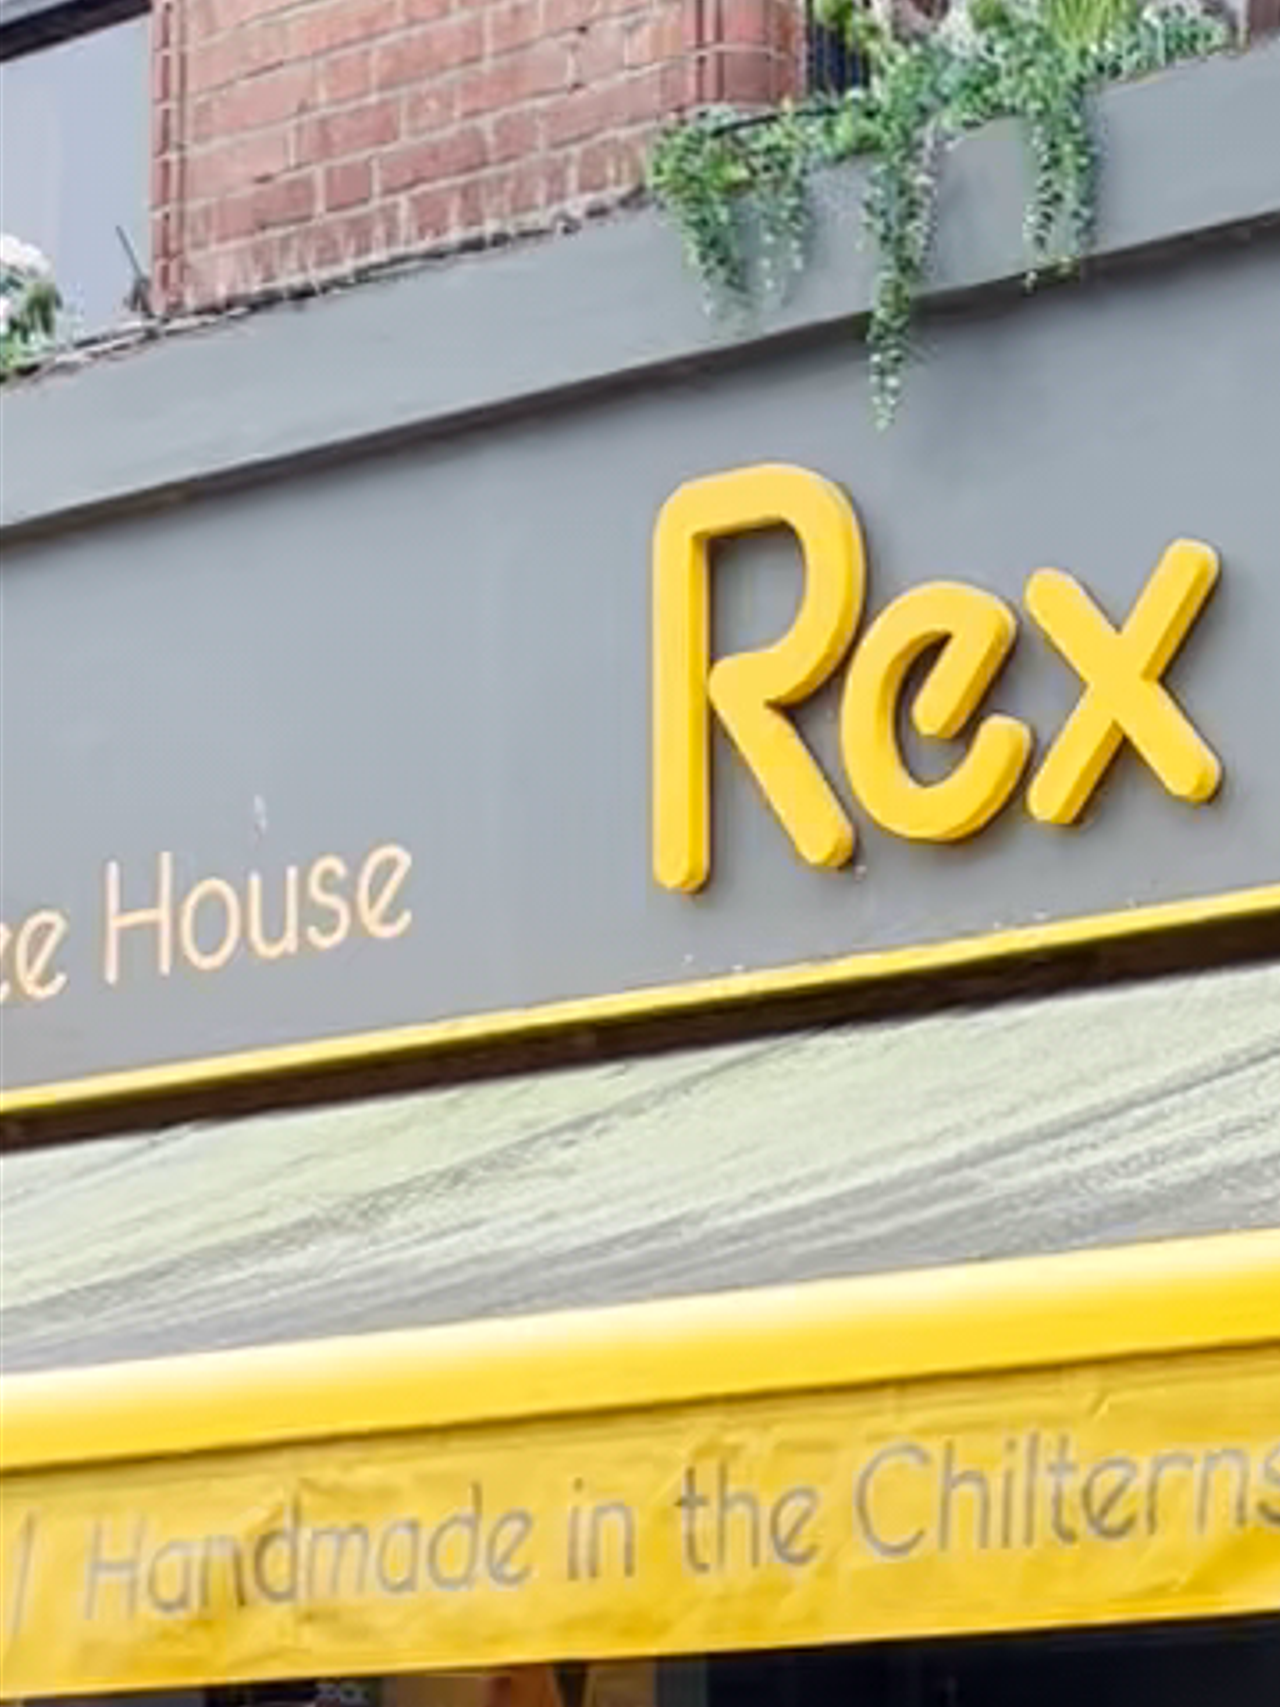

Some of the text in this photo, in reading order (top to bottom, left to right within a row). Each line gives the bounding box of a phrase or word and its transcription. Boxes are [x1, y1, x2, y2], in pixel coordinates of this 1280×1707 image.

[652, 462, 1223, 895] Rex
[102, 841, 413, 987] House
[84, 1480, 534, 1621] Handmade
[565, 1477, 636, 1581] in
[674, 1459, 820, 1574] the
